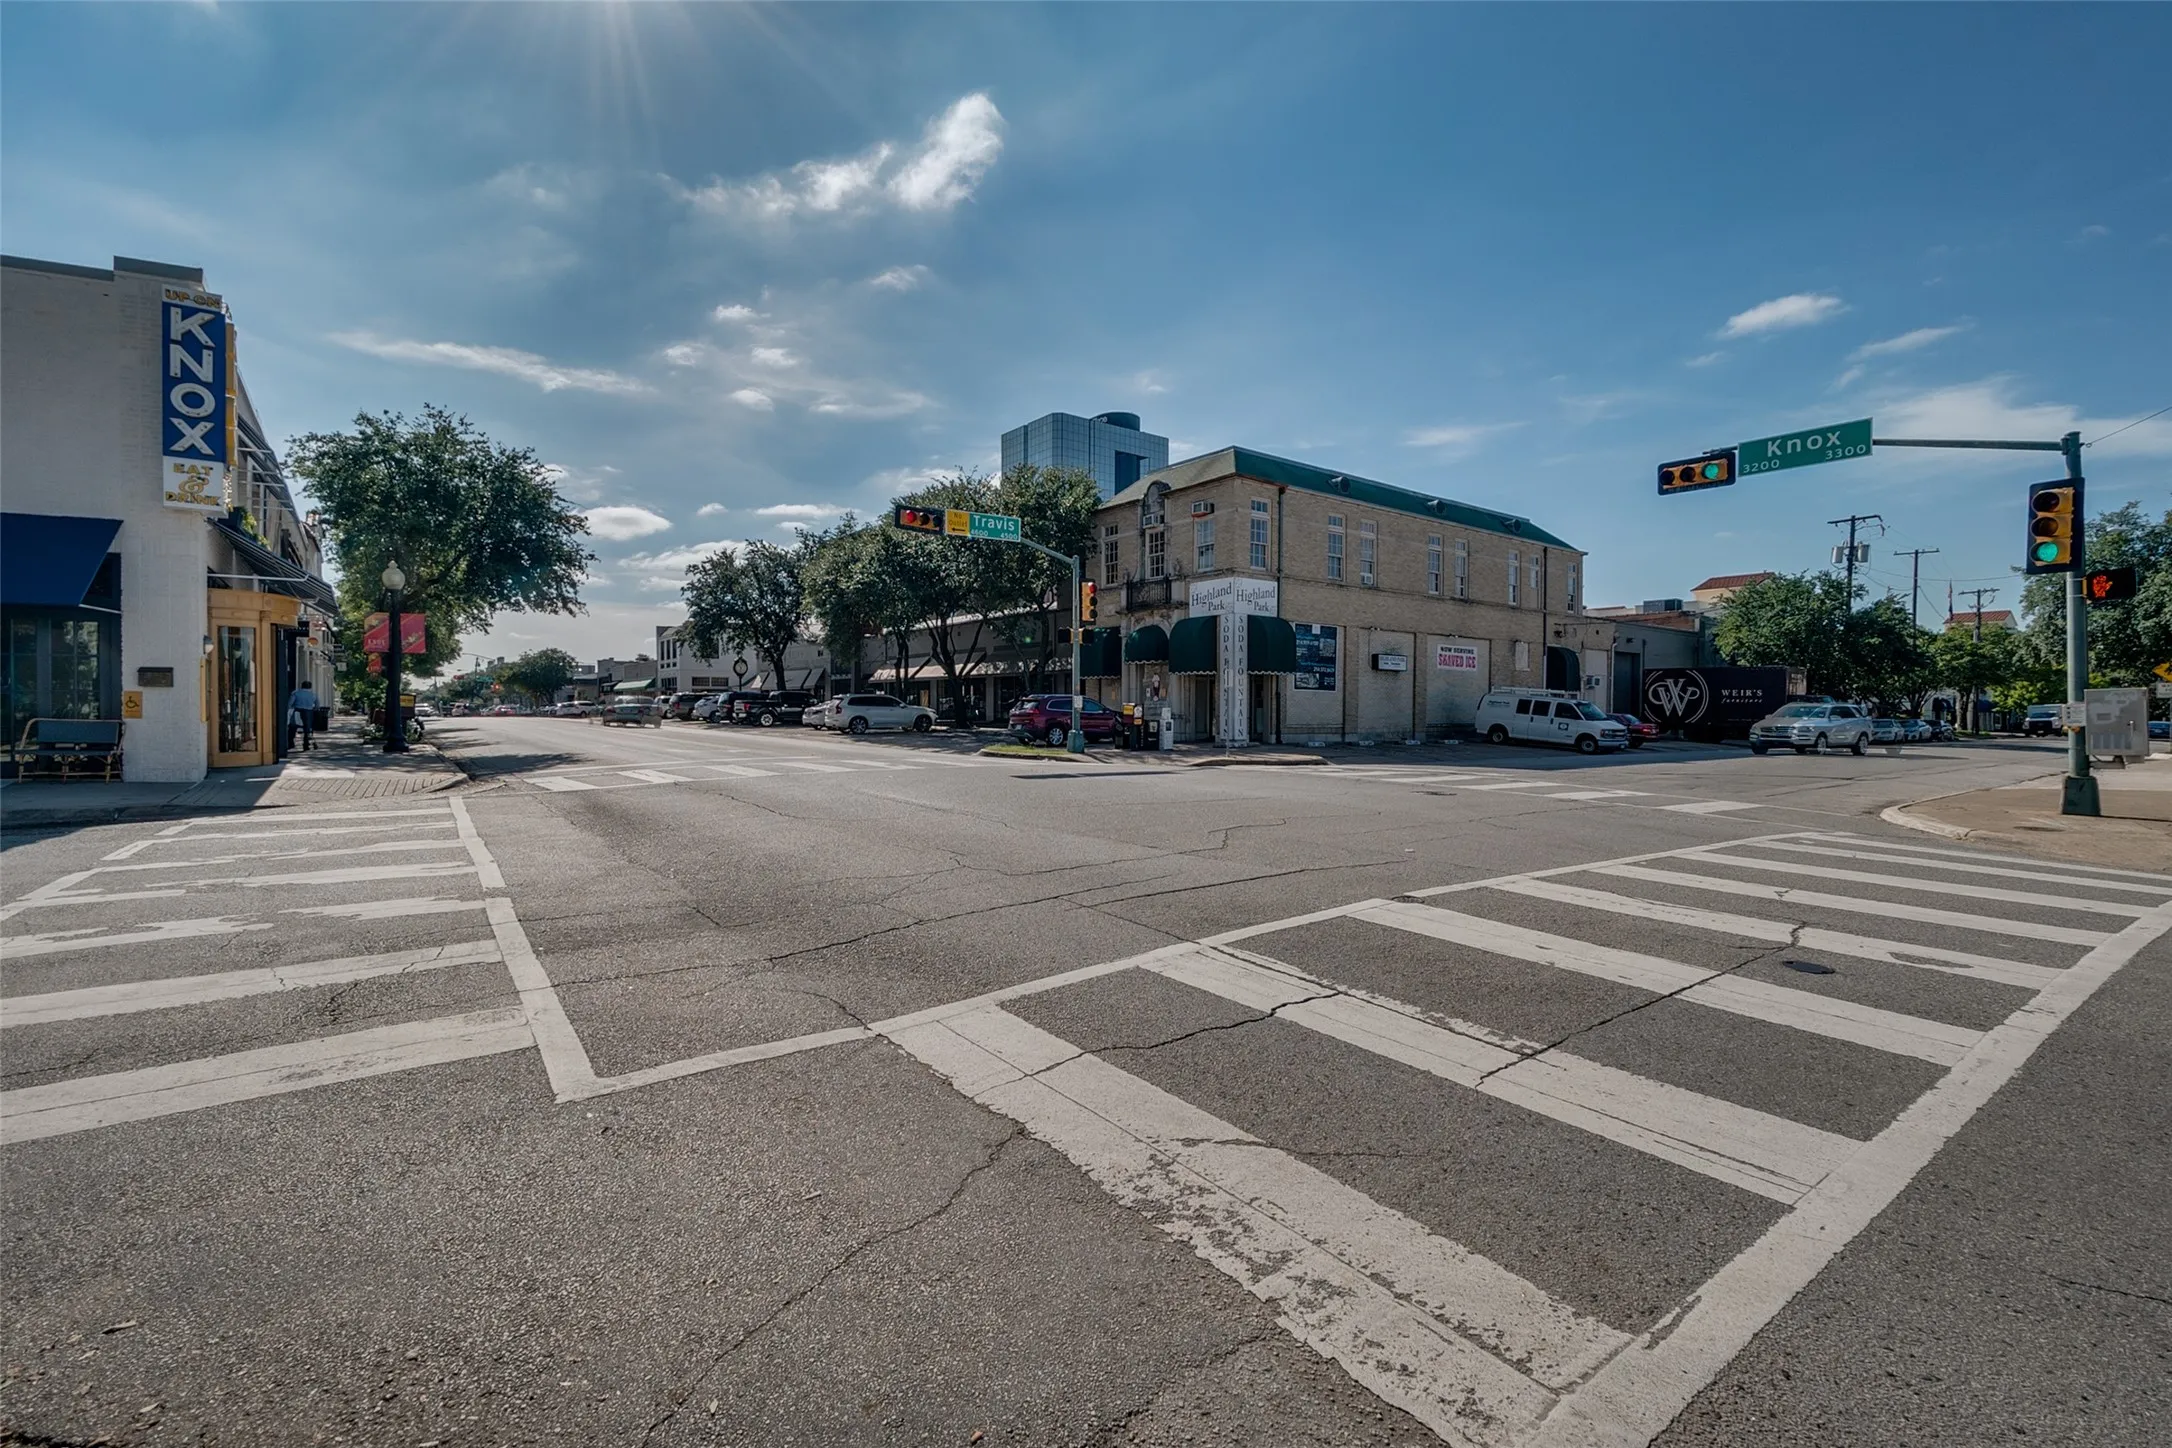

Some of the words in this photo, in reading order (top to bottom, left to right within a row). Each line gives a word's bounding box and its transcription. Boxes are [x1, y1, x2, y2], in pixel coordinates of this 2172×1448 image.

[165, 288, 191, 302] UP
[193, 294, 221, 309] ON
[168, 306, 216, 456] KNOX
[1767, 431, 1842, 457] Knox
[1743, 459, 1780, 474] 3200
[1825, 444, 1867, 460] 3300
[173, 463, 213, 476] EAT
[165, 491, 221, 506] DRINK
[973, 514, 1015, 531] Travis
[1000, 532, 1018, 540] 4500
[1191, 582, 1232, 607] Highland
[1236, 586, 1276, 605] Highland
[1208, 600, 1226, 612] Park
[1254, 601, 1270, 612] Park
[1438, 653, 1464, 667] SHAVED
[1465, 655, 1476, 668] ICE
[1721, 689, 1763, 697] WEIR'S
